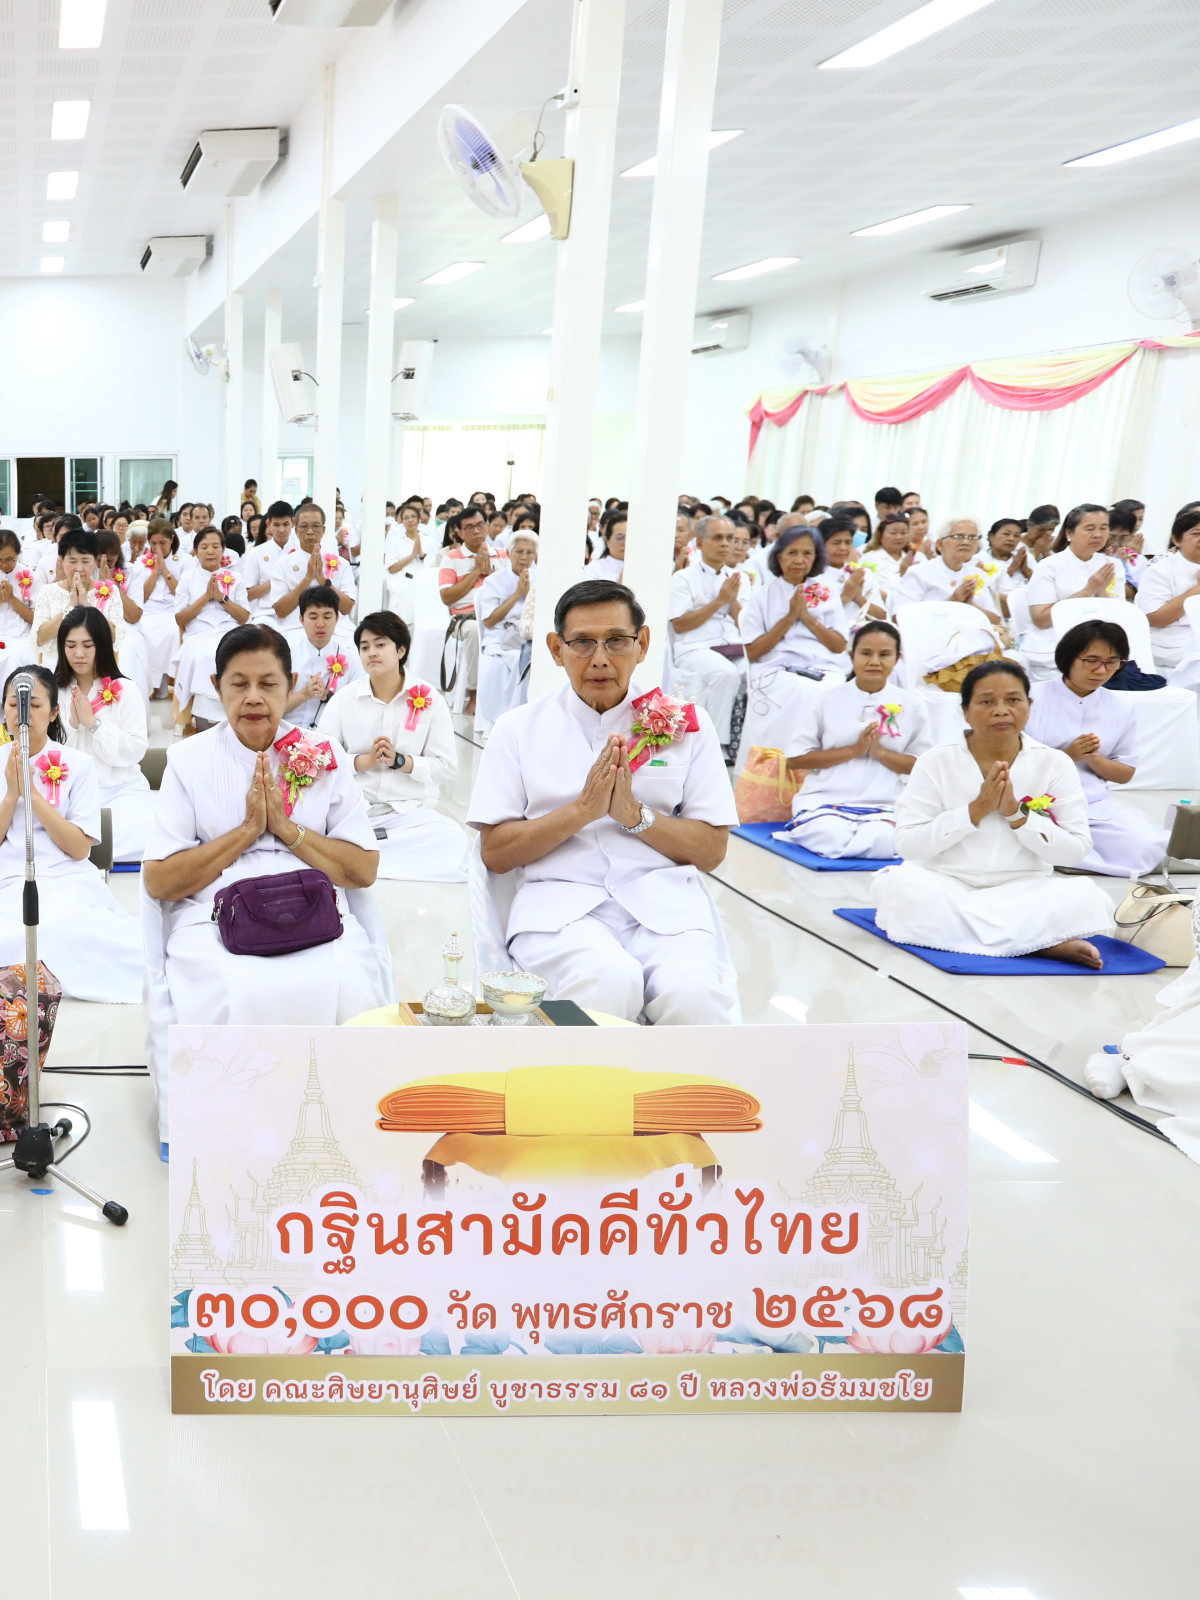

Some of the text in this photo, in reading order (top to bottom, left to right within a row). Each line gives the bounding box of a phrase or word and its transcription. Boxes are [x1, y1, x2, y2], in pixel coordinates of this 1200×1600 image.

[276, 1172, 859, 1275] กฐินสามัคคีทั่วไทย
[196, 1285, 944, 1345] ๓๐,๐๐๐ วัด พุทธศักราช ๒๕๖๘
[203, 1370, 930, 1409] โดย คณะศิษยานุศิษย์ บูชาธรรม ๘๑ ปี หลวงพ่อธัมมชโย
